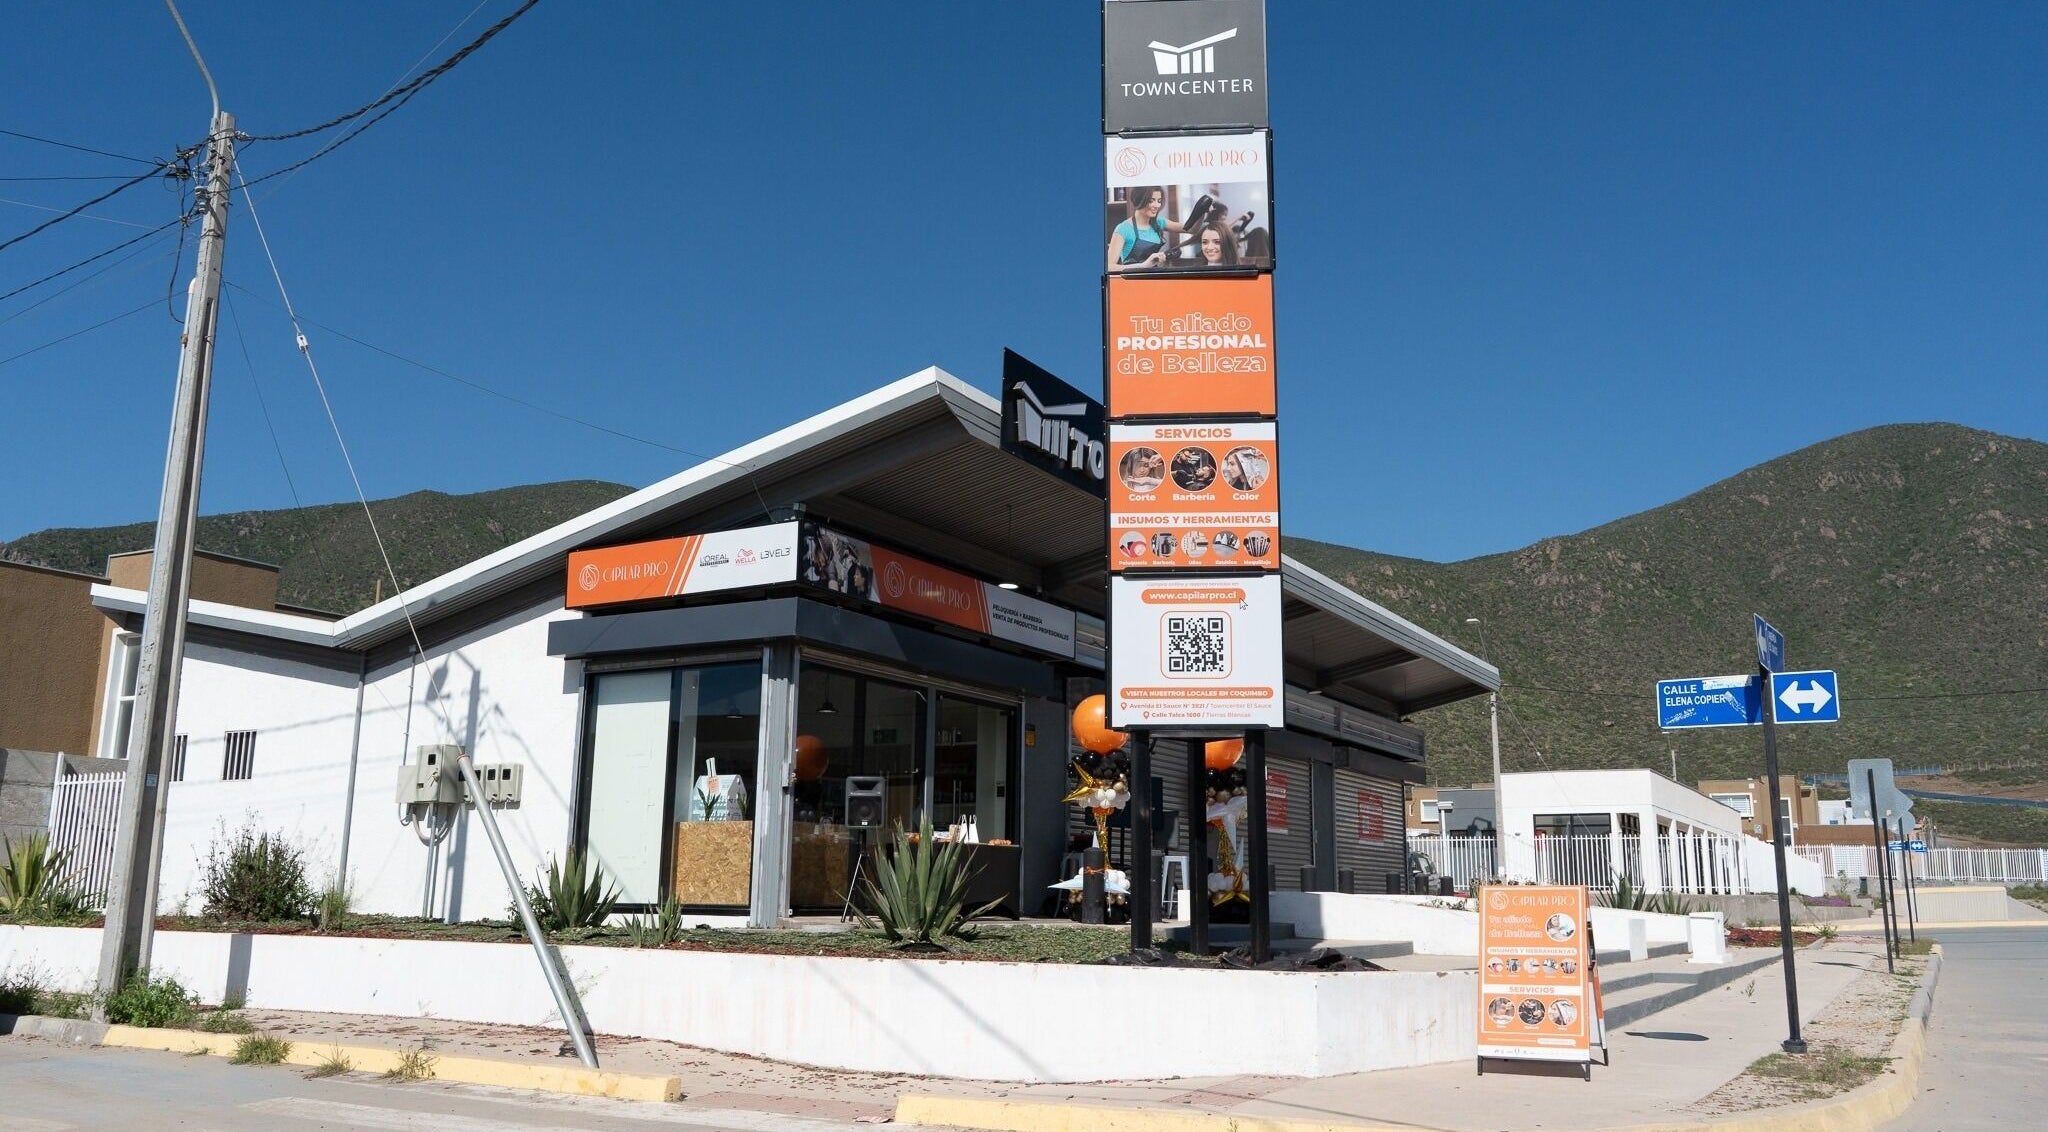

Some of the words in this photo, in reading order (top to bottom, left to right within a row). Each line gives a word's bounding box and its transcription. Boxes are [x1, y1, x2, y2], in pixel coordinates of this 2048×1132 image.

[1121, 78, 1254, 97] TOWNCENTER
[1220, 149, 1258, 167] PRO
[1130, 314, 1164, 334] Tu
[1170, 312, 1252, 333] aliado
[1118, 334, 1266, 351] PROFESIONAL
[1118, 354, 1154, 375] de
[1162, 352, 1267, 374] Belleza
[1154, 428, 1232, 439] SERVICIOS
[1128, 492, 1156, 502] Corte
[1232, 492, 1260, 502] Color
[1118, 515, 1170, 525] INSUMOS
[1172, 515, 1180, 525] Y
[1182, 514, 1272, 524] HERRAMIENTAS
[602, 564, 640, 583] CAPILAR
[643, 560, 669, 578] PRO
[948, 590, 971, 611] PRO
[1149, 591, 1237, 601] www.capilarpro.cl
[1229, 690, 1268, 698] COQUIMBO
[1663, 684, 1698, 696] CALLE
[1666, 696, 1694, 707] ELENA
[1551, 896, 1576, 907] PRO
[1508, 986, 1555, 994] SERVICIOS
